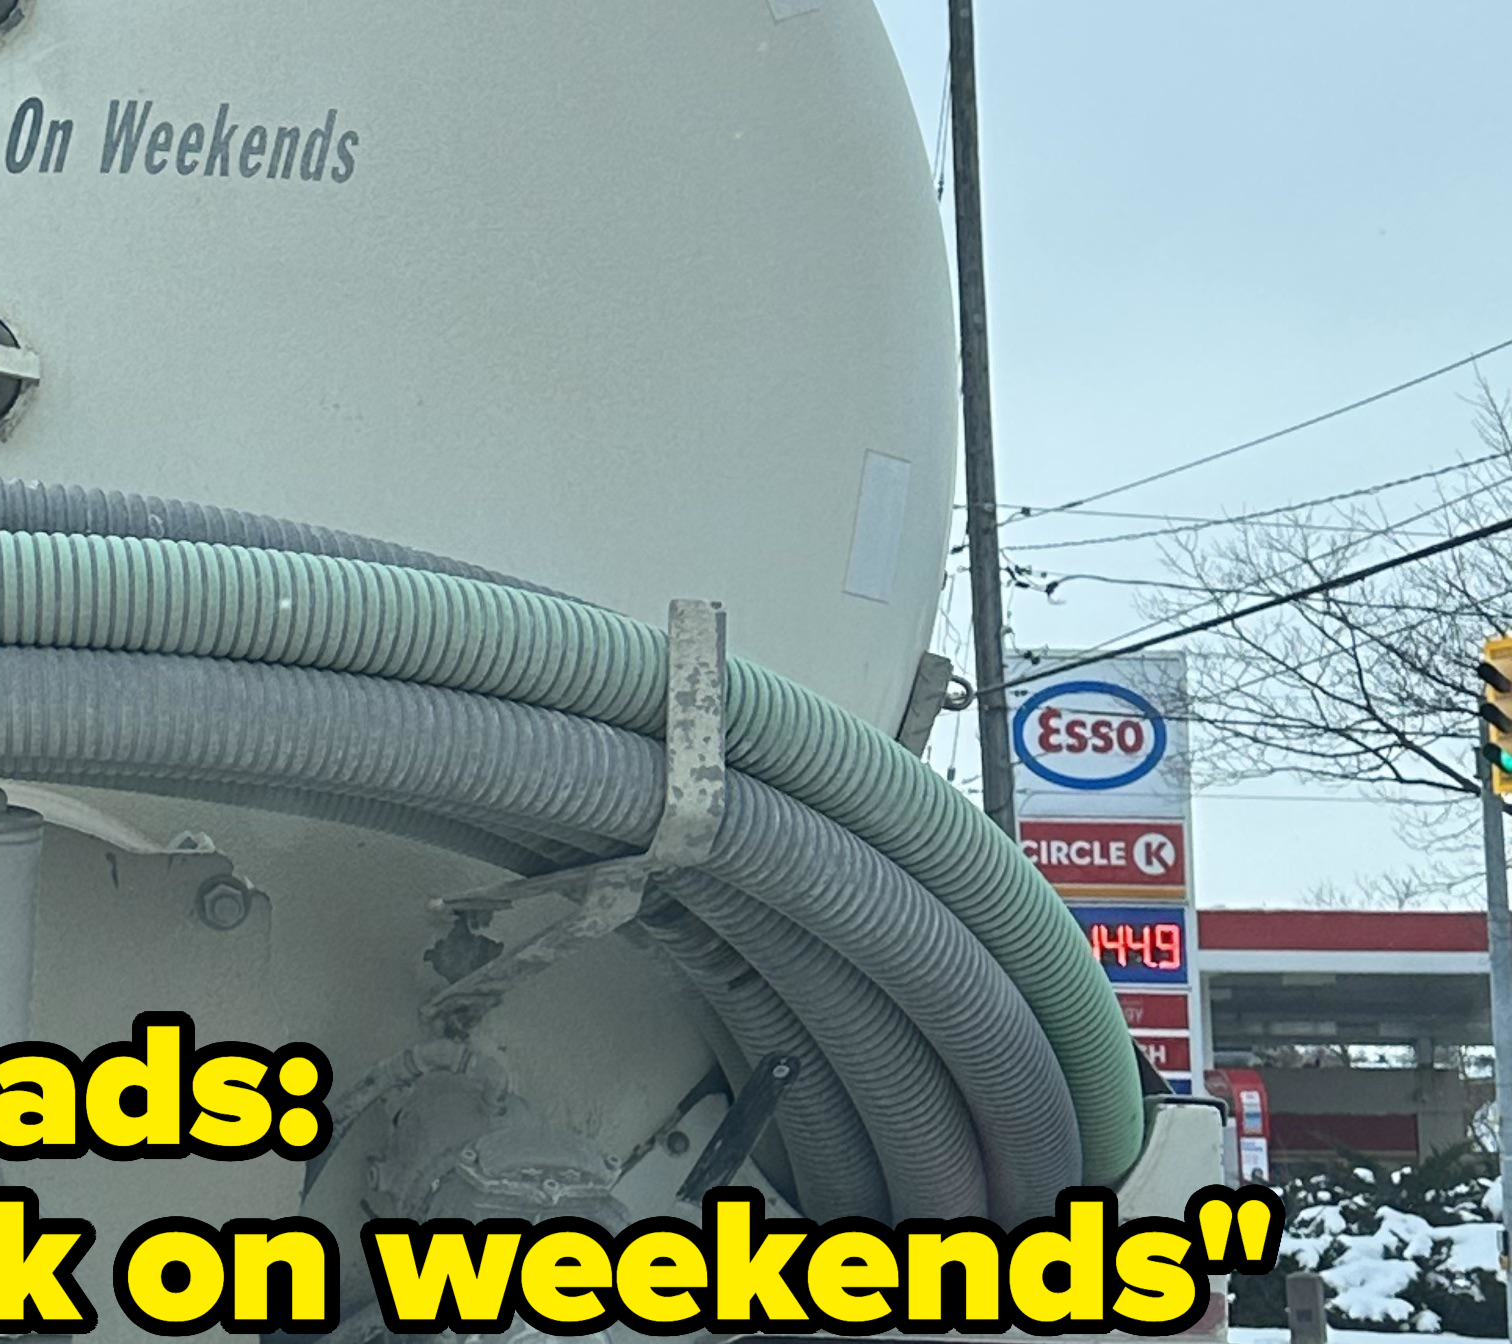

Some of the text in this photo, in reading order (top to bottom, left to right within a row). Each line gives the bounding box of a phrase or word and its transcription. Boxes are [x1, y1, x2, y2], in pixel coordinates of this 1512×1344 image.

[6, 96, 74, 175] On
[99, 99, 360, 184] Weekends
[1020, 832, 1176, 875] CIRCLE K
